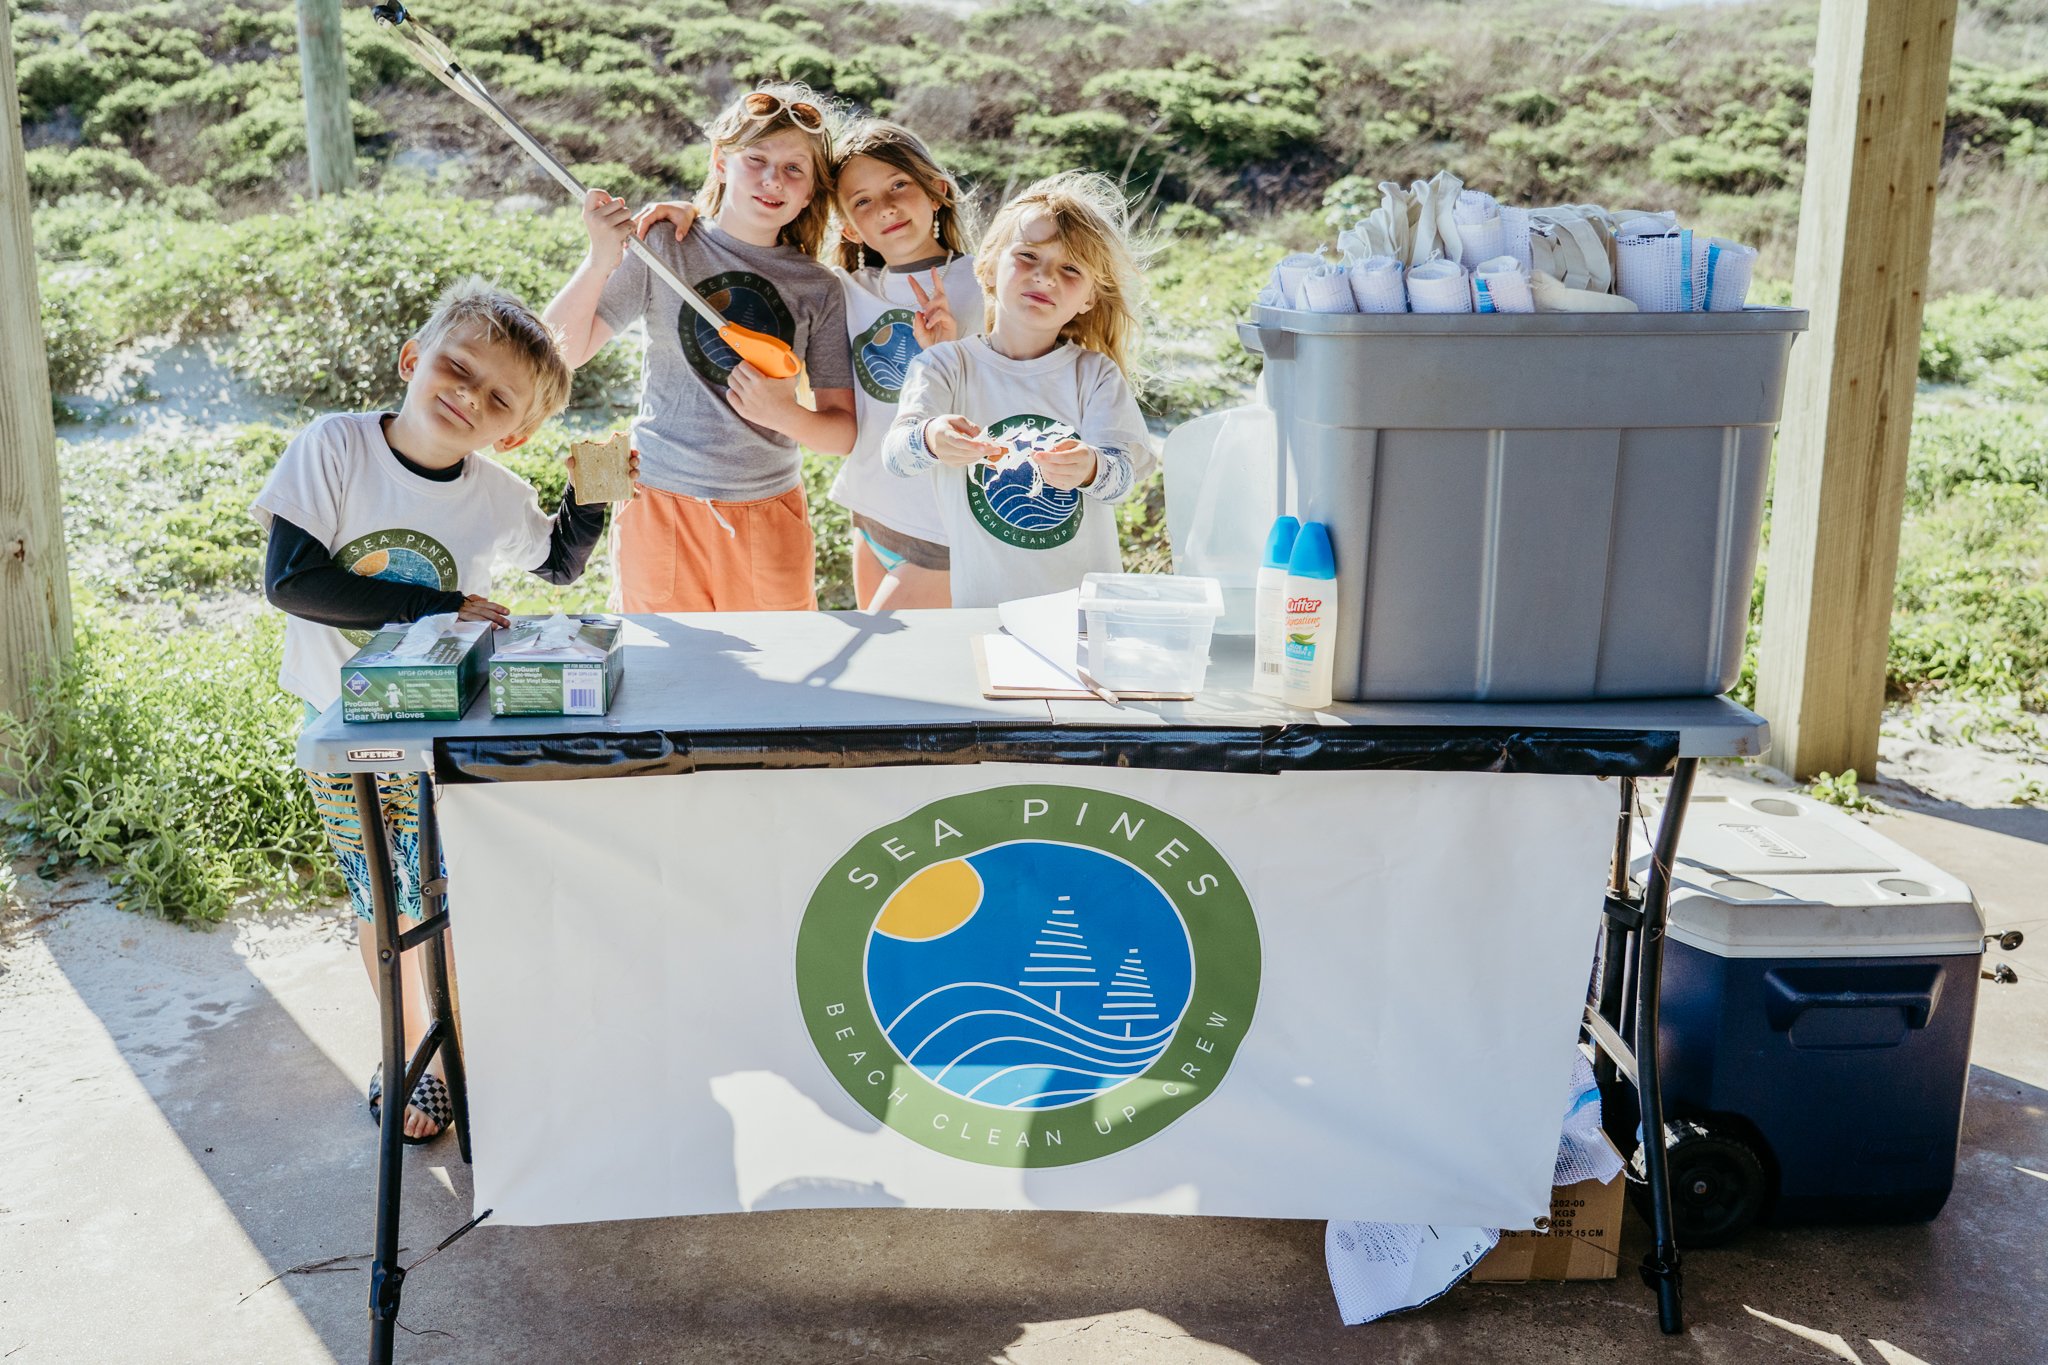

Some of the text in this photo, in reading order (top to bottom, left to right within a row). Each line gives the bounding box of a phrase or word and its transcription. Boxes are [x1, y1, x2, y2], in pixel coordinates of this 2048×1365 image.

[698, 275, 786, 317] SEA PINES
[872, 313, 894, 331] SEA
[971, 491, 997, 529] BEACH
[1003, 530, 1046, 544] CLEAN
[1054, 529, 1067, 540] UP
[349, 534, 453, 576] SEA PINES
[1286, 597, 1321, 613] Cutter
[371, 712, 393, 720] Vinyl
[395, 711, 425, 719] Gloves
[354, 751, 399, 759] LIFETIME
[848, 799, 1219, 897] SEA PINES
[826, 1003, 1228, 1148] BEACH CLEAN UP CREW
[1550, 1200, 1585, 1208] 202-00
